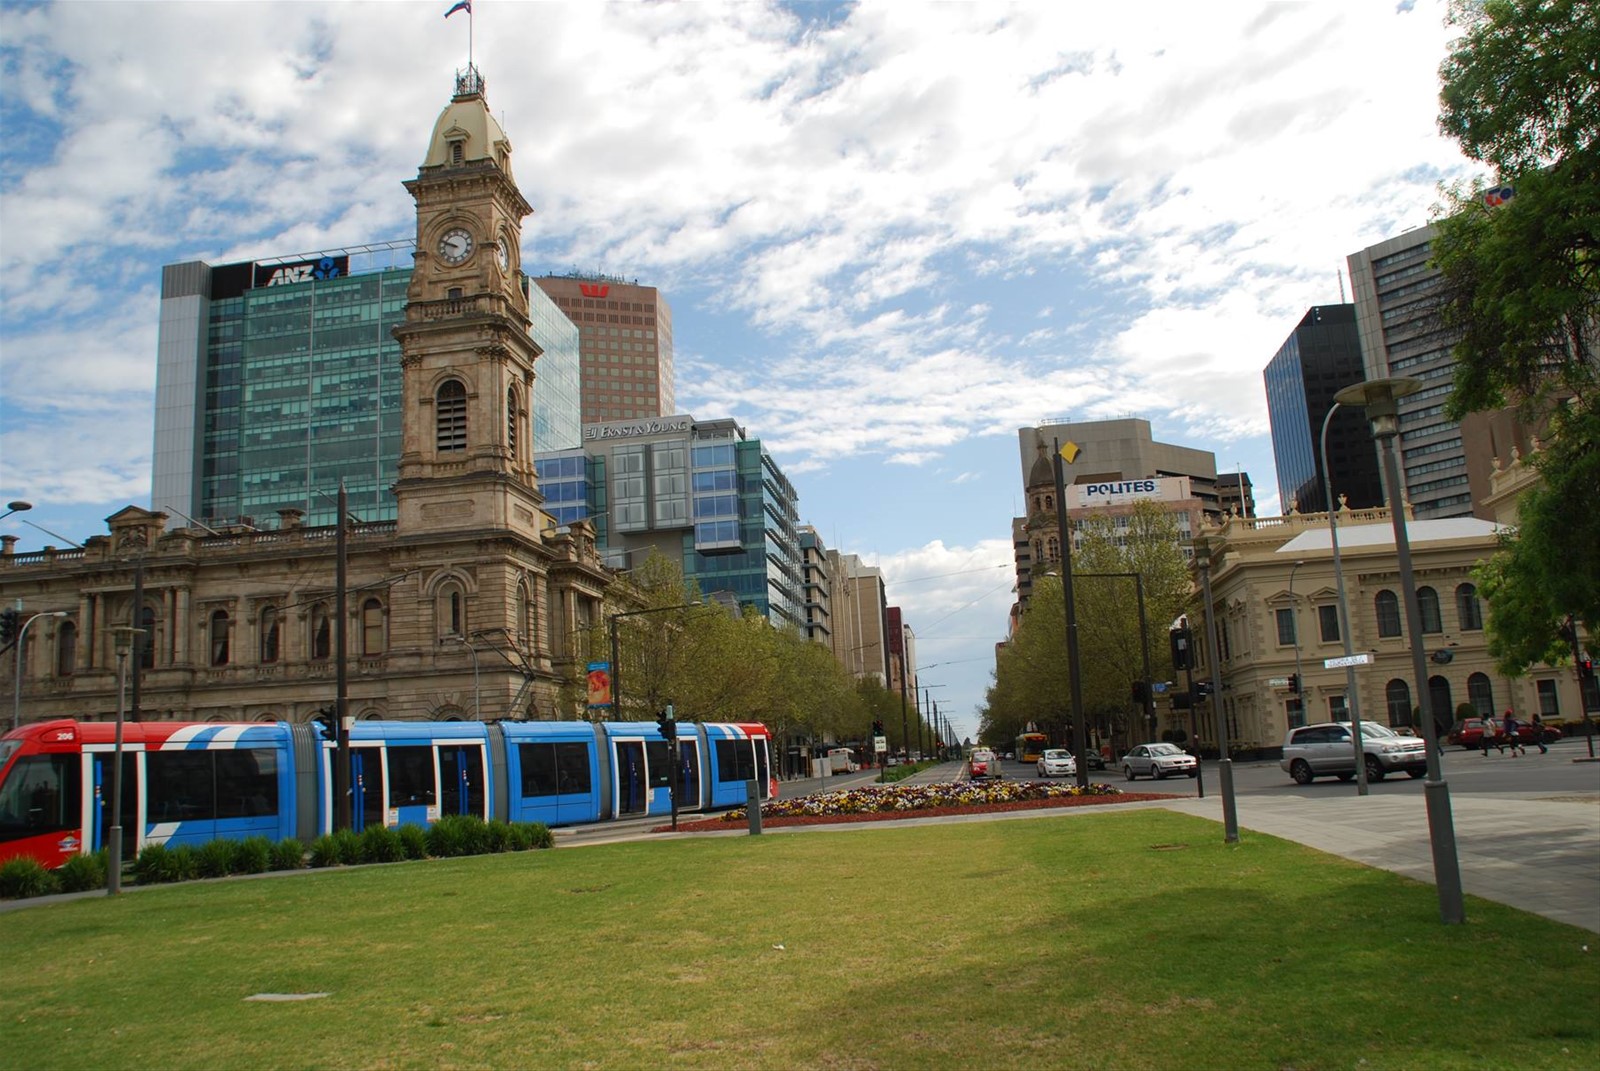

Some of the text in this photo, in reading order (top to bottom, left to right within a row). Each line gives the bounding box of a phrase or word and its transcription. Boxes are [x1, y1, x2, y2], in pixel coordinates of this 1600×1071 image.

[267, 264, 315, 287] ANZ
[601, 426, 634, 439] ERNST
[636, 425, 644, 435] &
[646, 421, 687, 434] YOUNG
[1087, 480, 1155, 496] POLITES
[57, 732, 74, 741] 206
